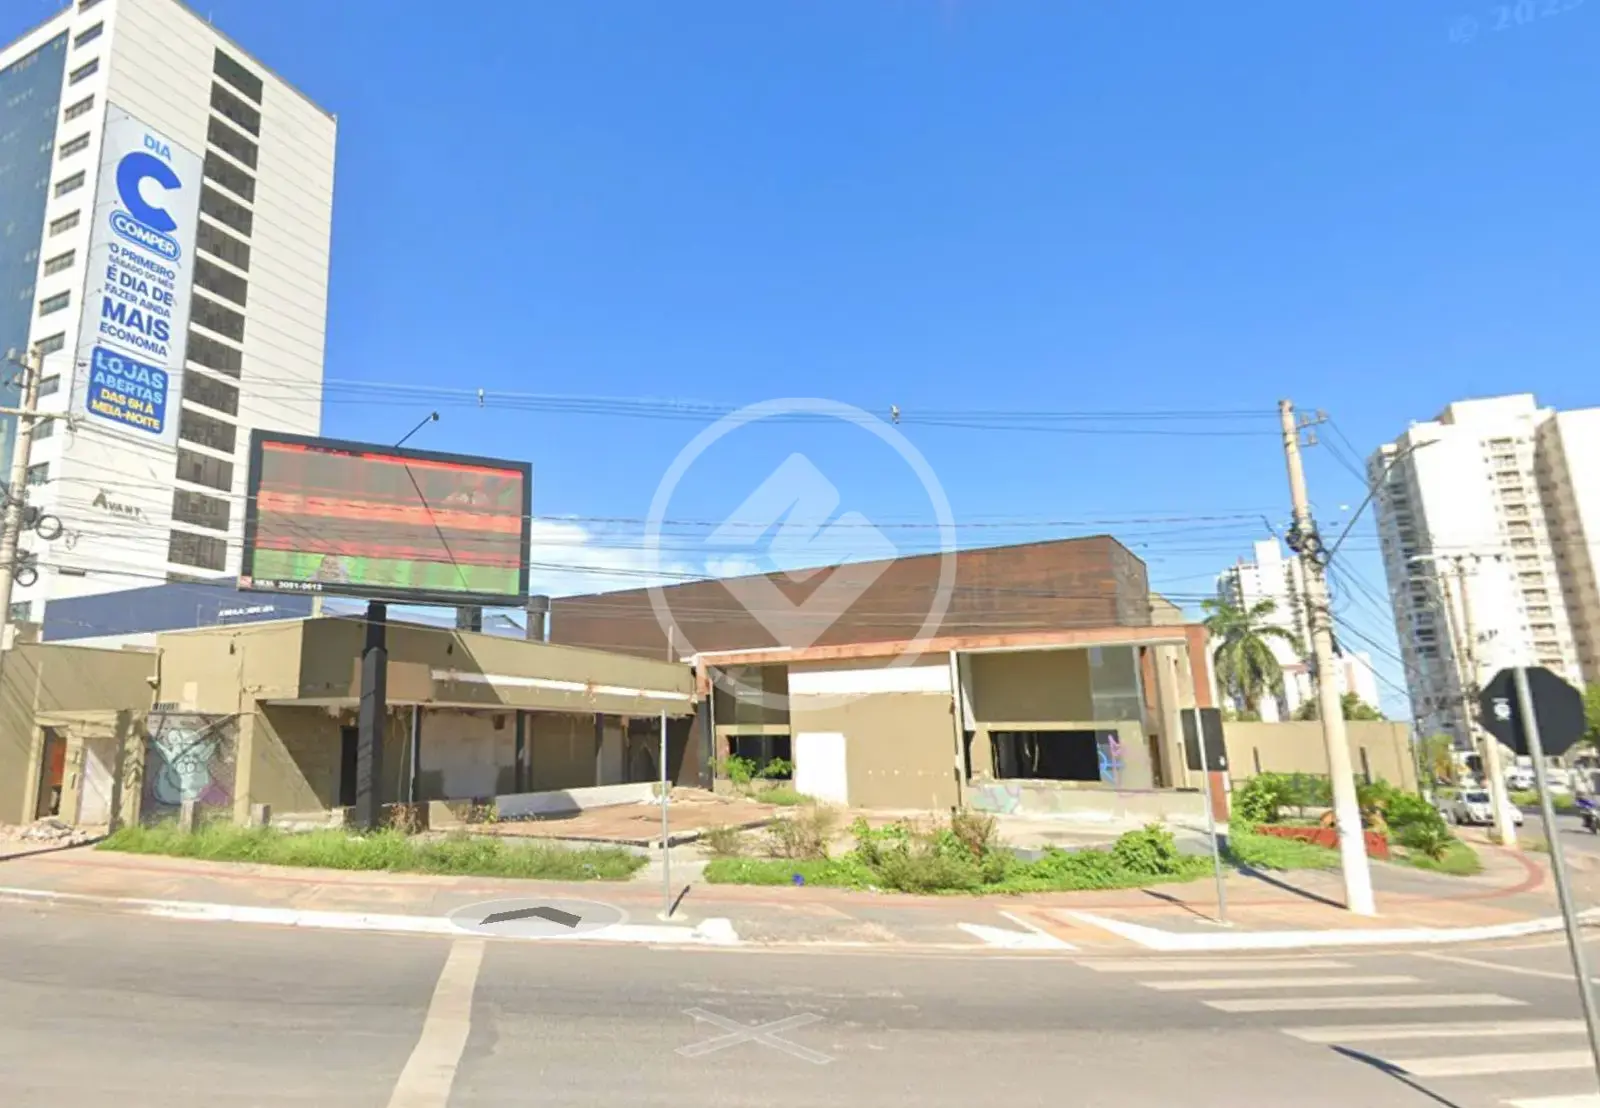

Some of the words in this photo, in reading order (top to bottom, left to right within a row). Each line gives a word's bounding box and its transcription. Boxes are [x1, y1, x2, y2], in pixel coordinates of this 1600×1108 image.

[143, 133, 172, 161] DIA
[116, 151, 182, 233] C
[115, 216, 176, 257] COMPER
[109, 242, 119, 253] O
[121, 247, 176, 281] PRIMEIRO
[104, 282, 138, 304] FAZER
[139, 298, 171, 318] AINDA
[106, 264, 117, 281] É
[120, 271, 149, 297] DIA
[152, 286, 174, 307] DE
[101, 296, 170, 342] MAIS
[99, 322, 168, 357] ECONOMIA
[94, 371, 163, 405] ABERTAS
[96, 351, 165, 389] LOJAS
[92, 398, 161, 430] MEIA-NOITE
[101, 388, 126, 405] DAS
